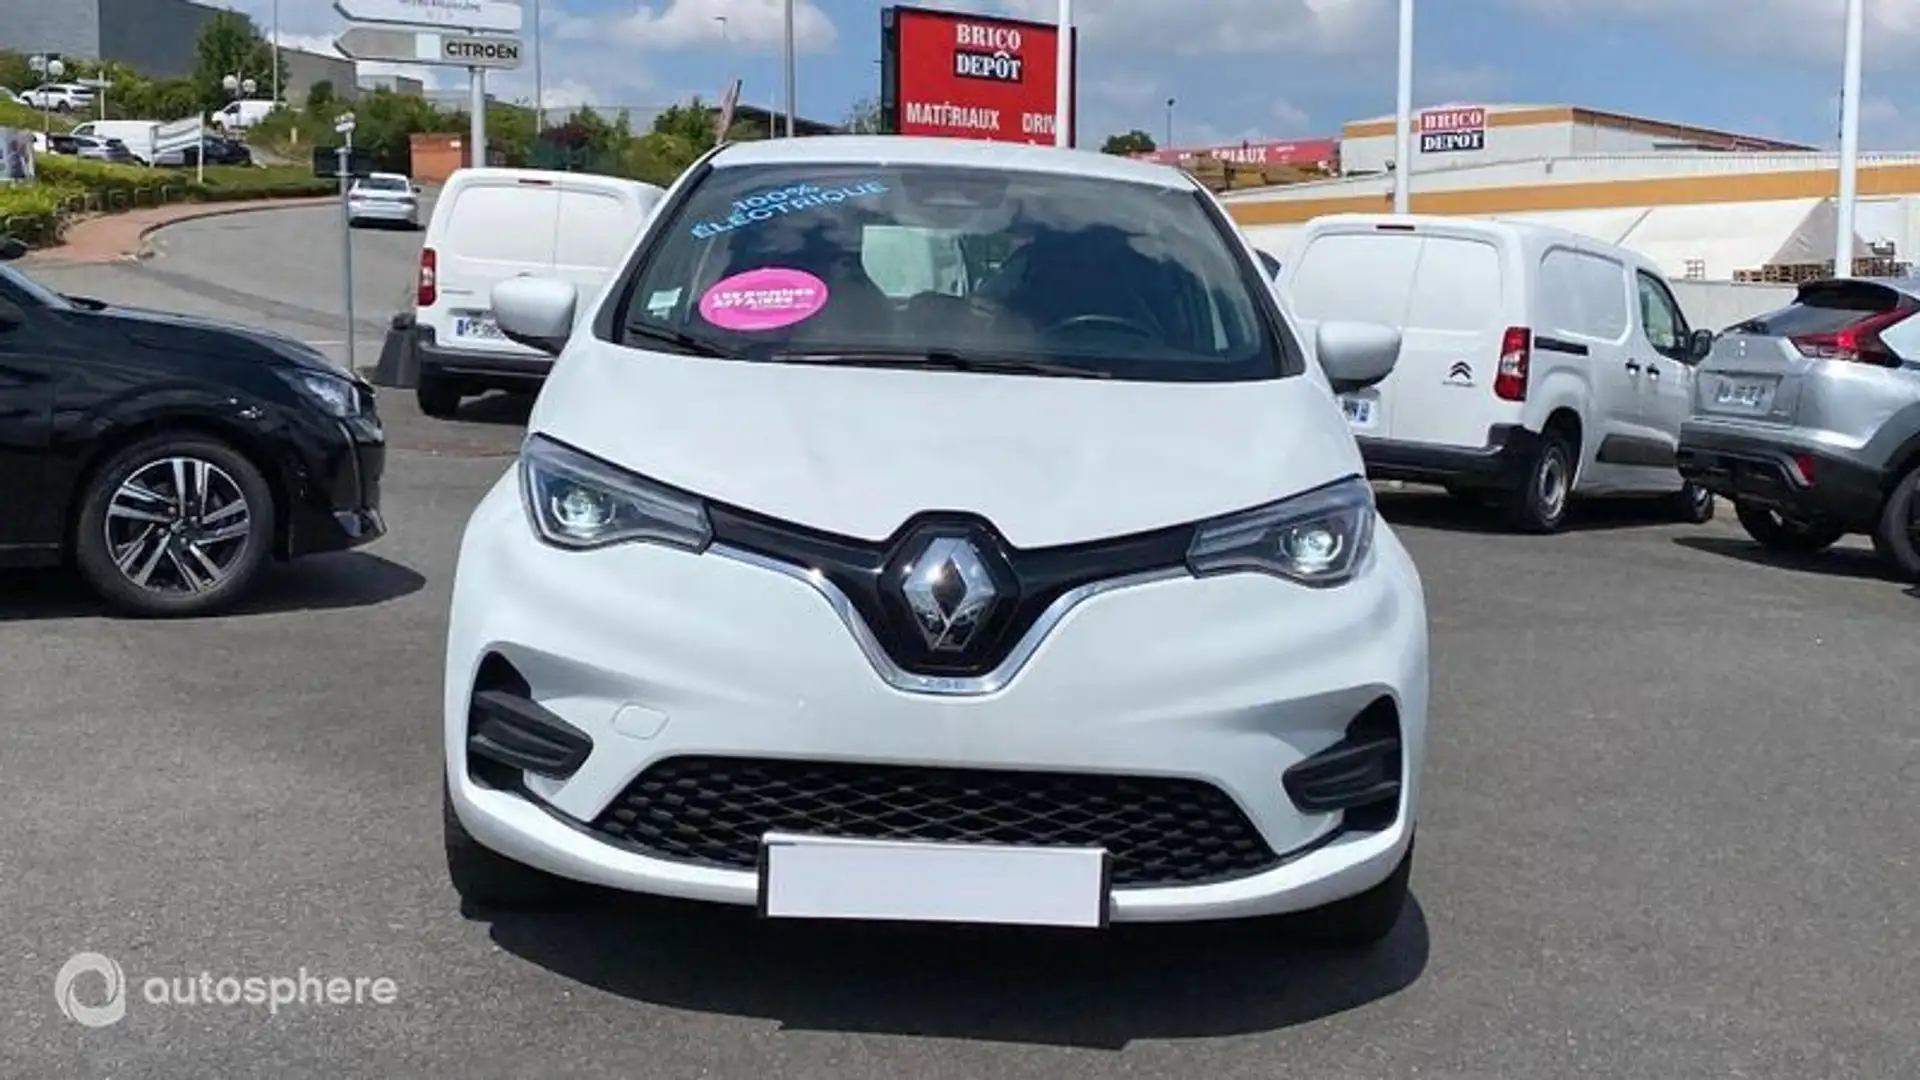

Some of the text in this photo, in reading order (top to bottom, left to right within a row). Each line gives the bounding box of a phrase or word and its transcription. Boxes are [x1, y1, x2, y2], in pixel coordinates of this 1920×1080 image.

[957, 23, 1021, 50] BRICO
[956, 50, 1021, 80] DEPÔT
[906, 101, 1058, 134] MATÉRIAUX DRIV
[1424, 111, 1482, 129] BRICO
[732, 183, 820, 212] 100%
